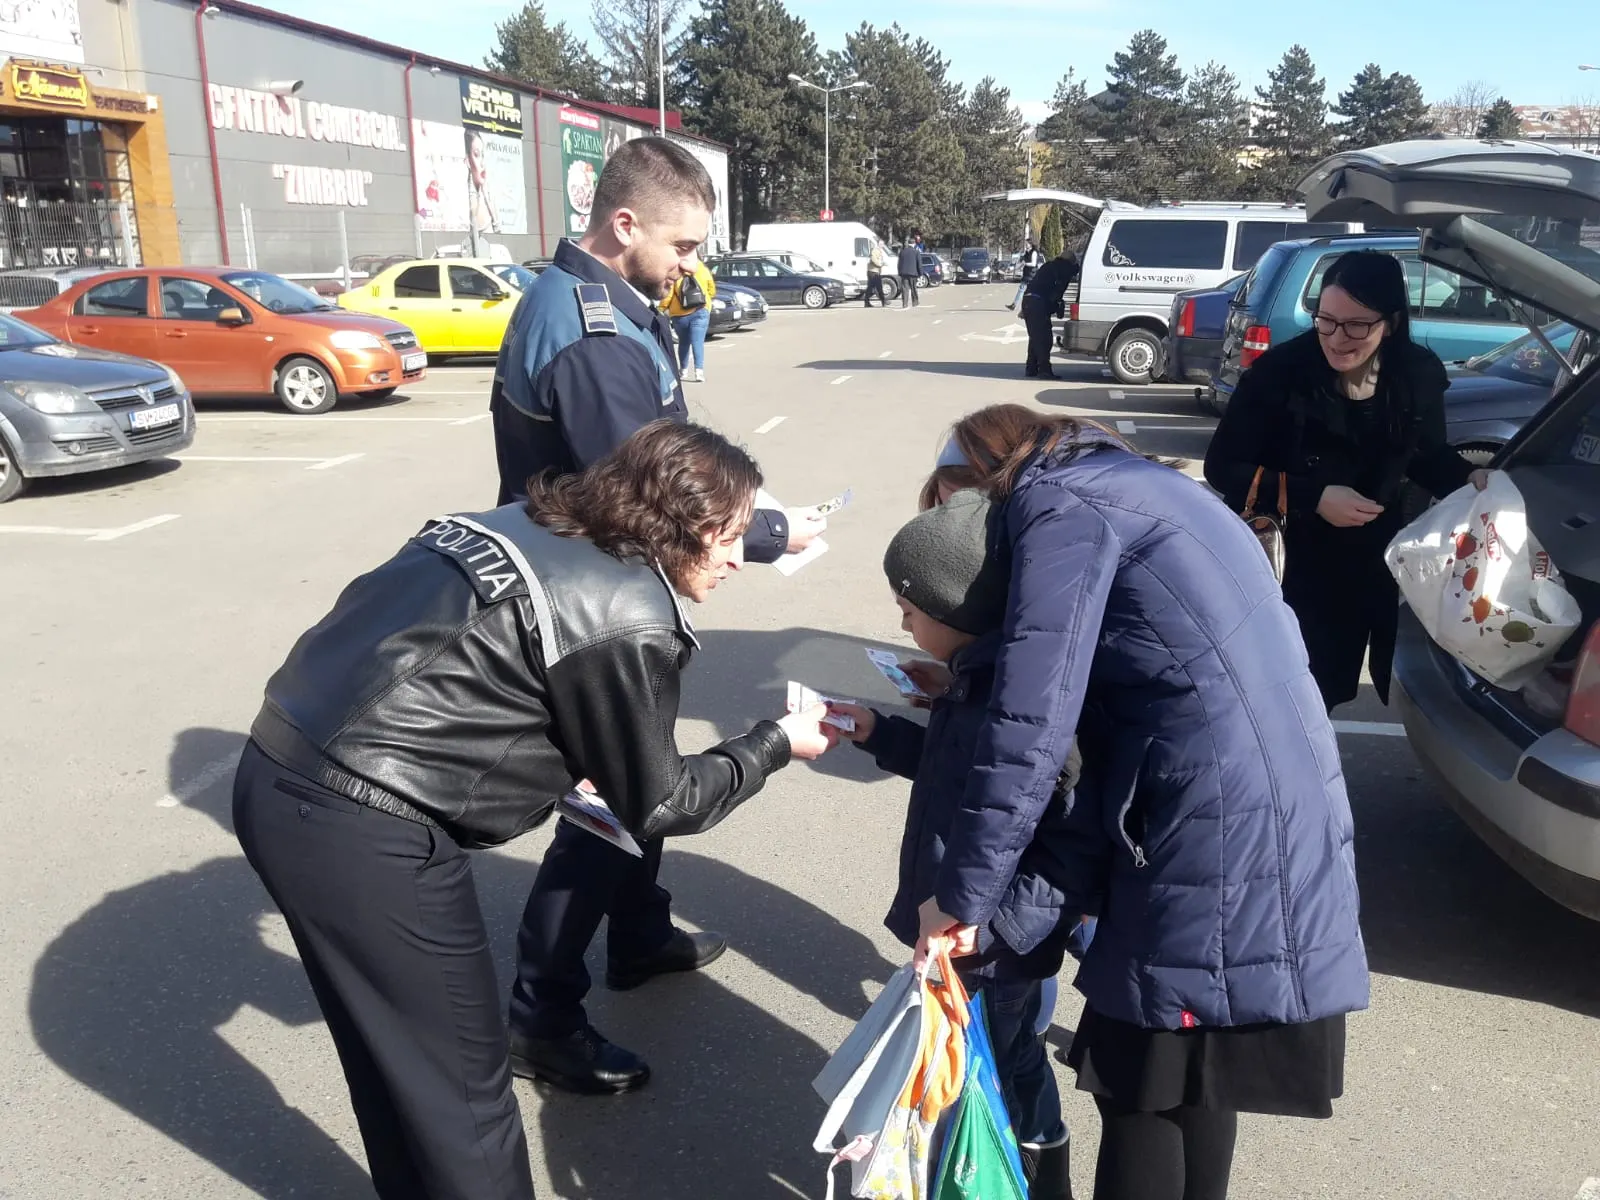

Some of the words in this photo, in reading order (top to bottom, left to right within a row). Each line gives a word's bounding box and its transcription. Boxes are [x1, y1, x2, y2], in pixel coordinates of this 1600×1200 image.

[462, 96, 522, 124] VALUTAR
[573, 131, 603, 154] SPARTAN
[1116, 272, 1184, 284] Volkswagen
[419, 522, 518, 599] POLITIA
